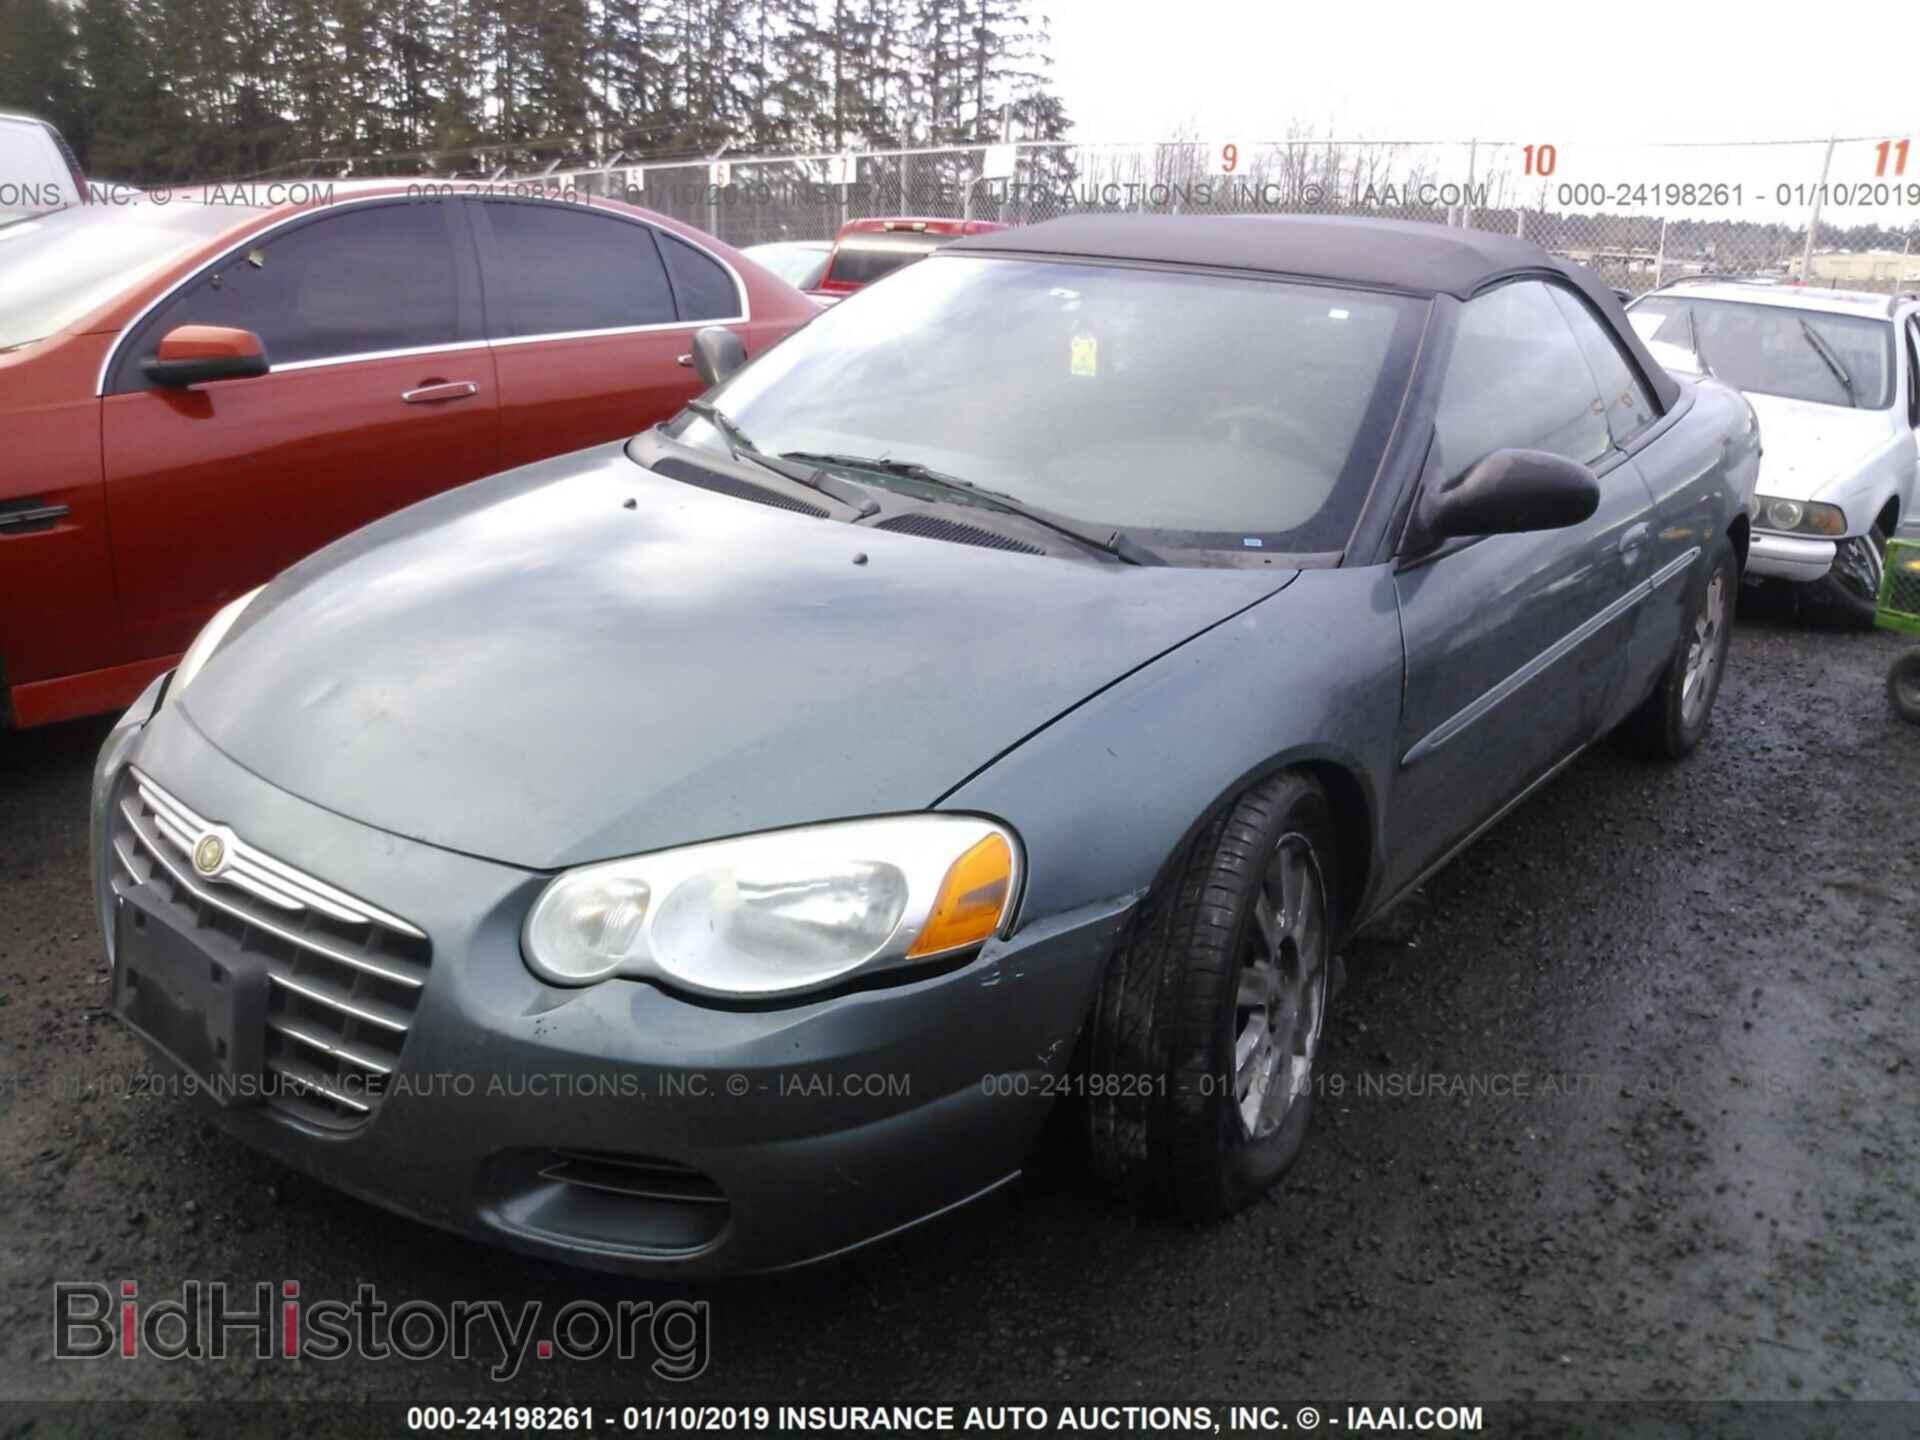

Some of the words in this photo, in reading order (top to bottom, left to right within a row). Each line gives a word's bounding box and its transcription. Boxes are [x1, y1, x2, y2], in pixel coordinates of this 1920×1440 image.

[1221, 142, 1239, 173] 9
[1522, 143, 1557, 176] 10
[1874, 139, 1911, 178] 11
